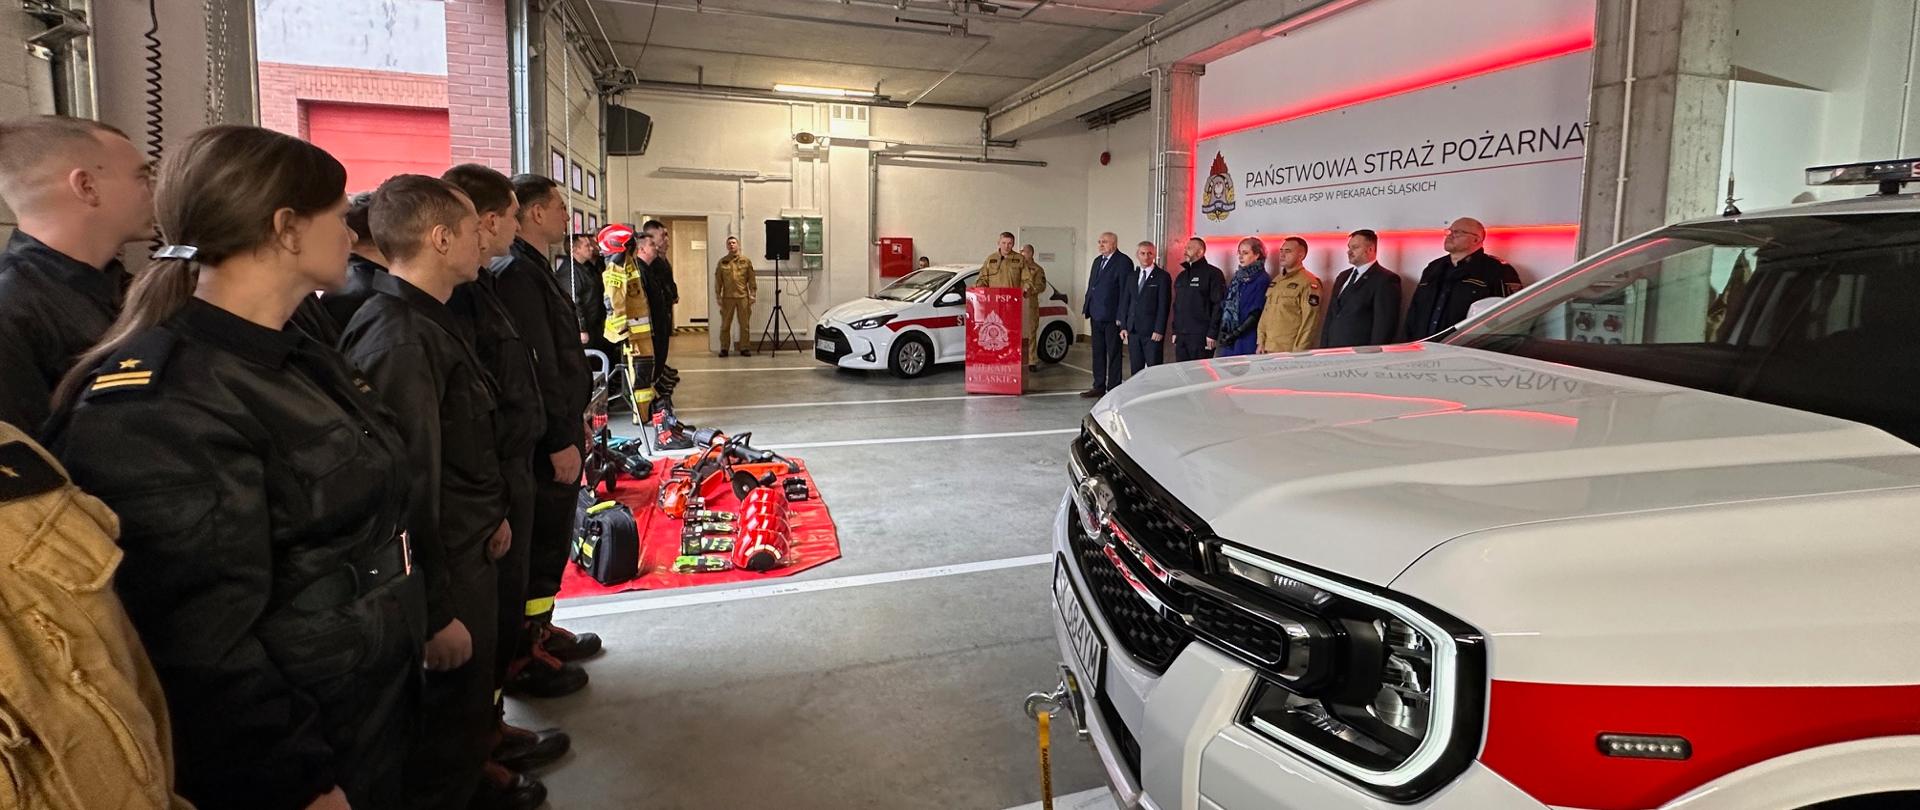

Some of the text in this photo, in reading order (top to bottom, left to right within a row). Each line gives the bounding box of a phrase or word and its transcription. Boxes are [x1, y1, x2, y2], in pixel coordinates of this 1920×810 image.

[1246, 122, 1585, 188] PAŃSTWOWA STRAŻ POŻARNA
[1245, 180, 1437, 208] KOMENDA MIEJSKA PSP W PIEKARACH ŚLĄSKICH
[995, 294, 1012, 303] PSP
[1068, 597, 1098, 681] 684YM
